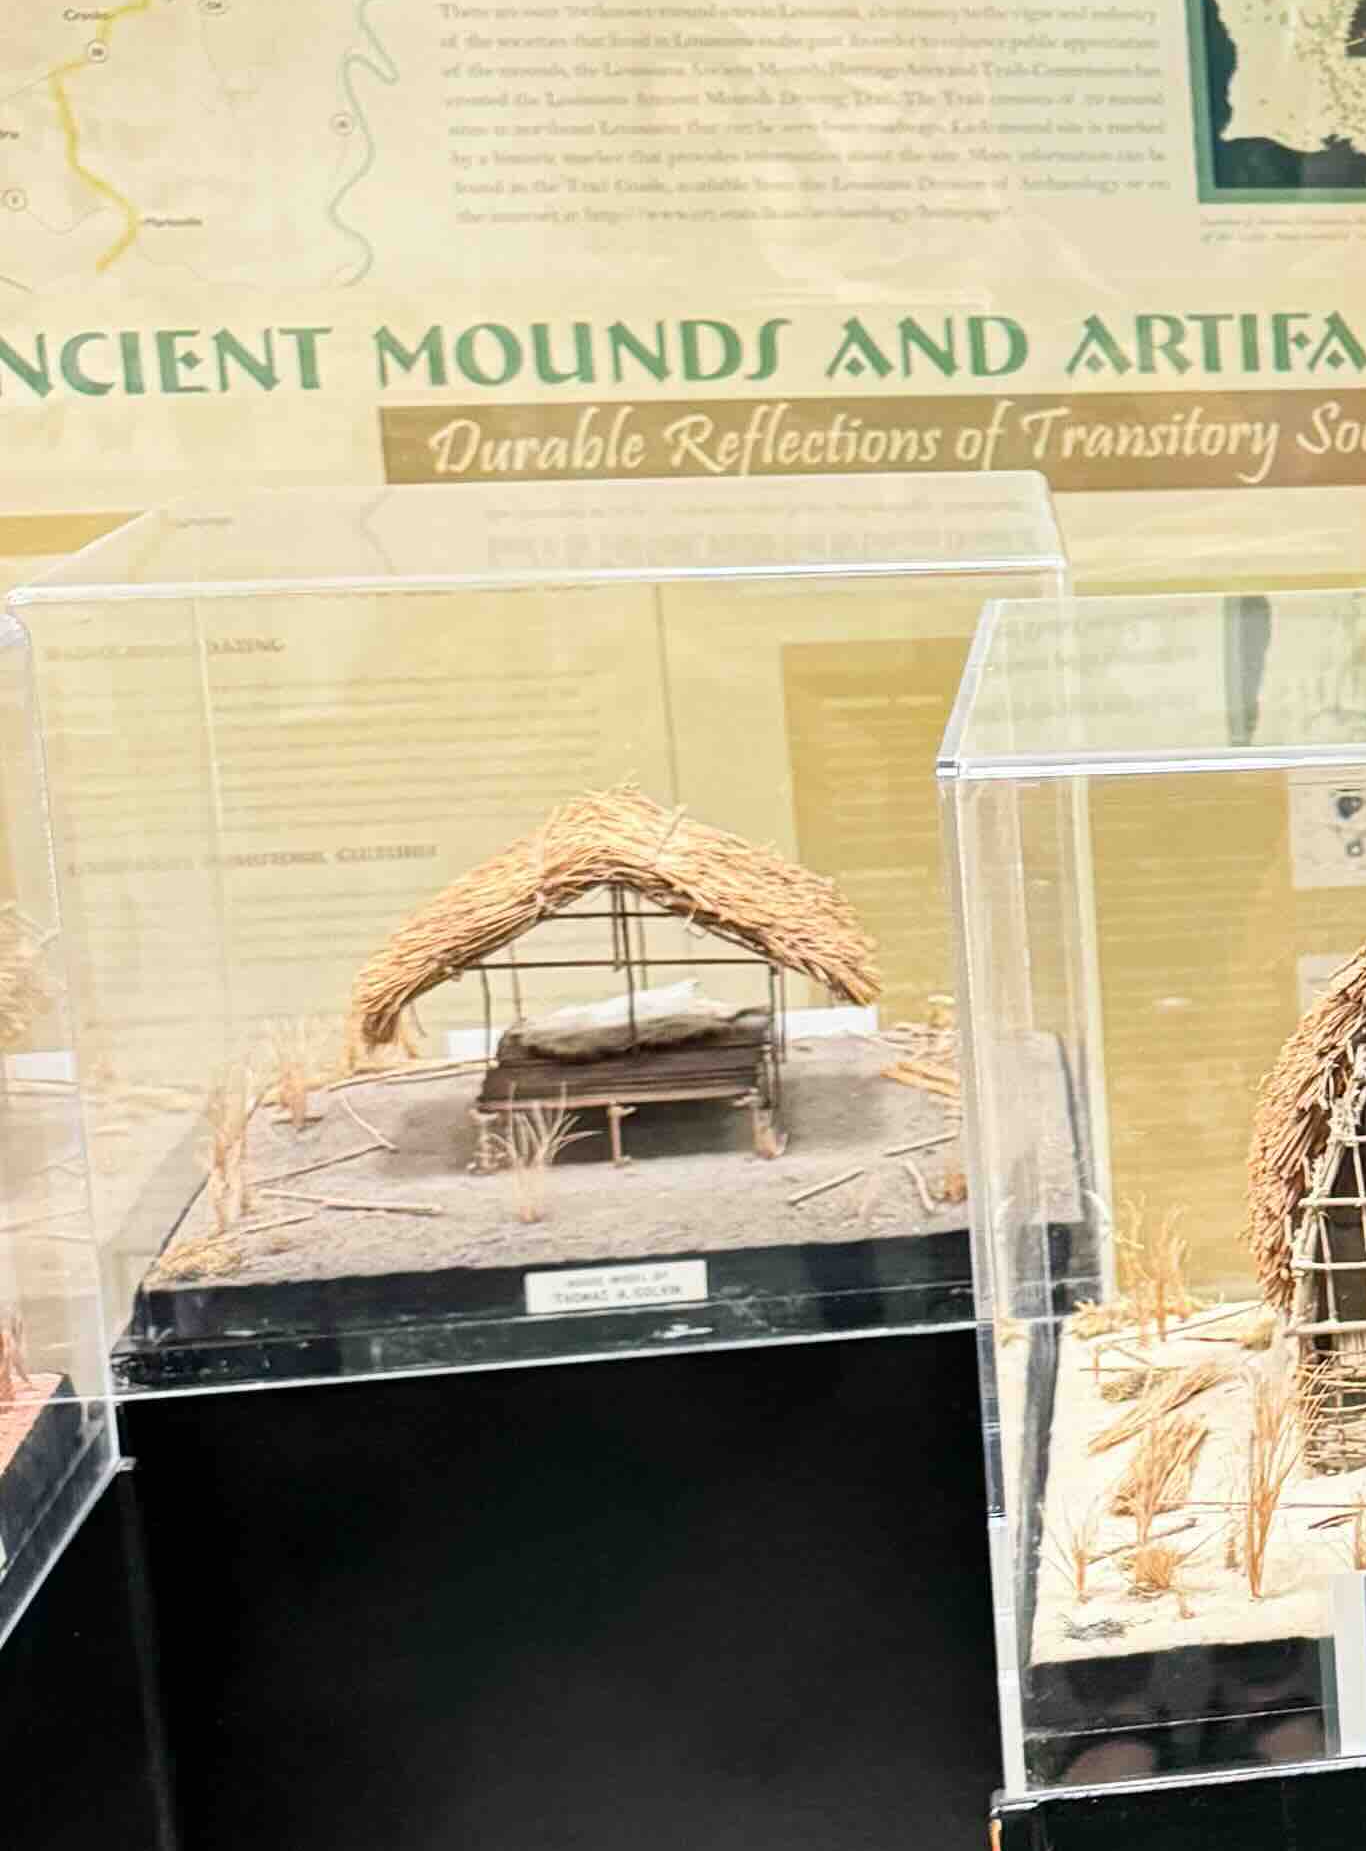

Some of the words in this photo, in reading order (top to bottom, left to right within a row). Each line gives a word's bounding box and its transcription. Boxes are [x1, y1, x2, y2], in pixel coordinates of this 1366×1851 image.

[0, 328, 332, 398] NCIENT
[373, 317, 792, 388] MOUNDS
[826, 315, 1029, 378] AND
[428, 406, 646, 474] Durable
[663, 402, 939, 477] Reflections
[956, 399, 1014, 470] of
[1019, 406, 1279, 484] Transitory
